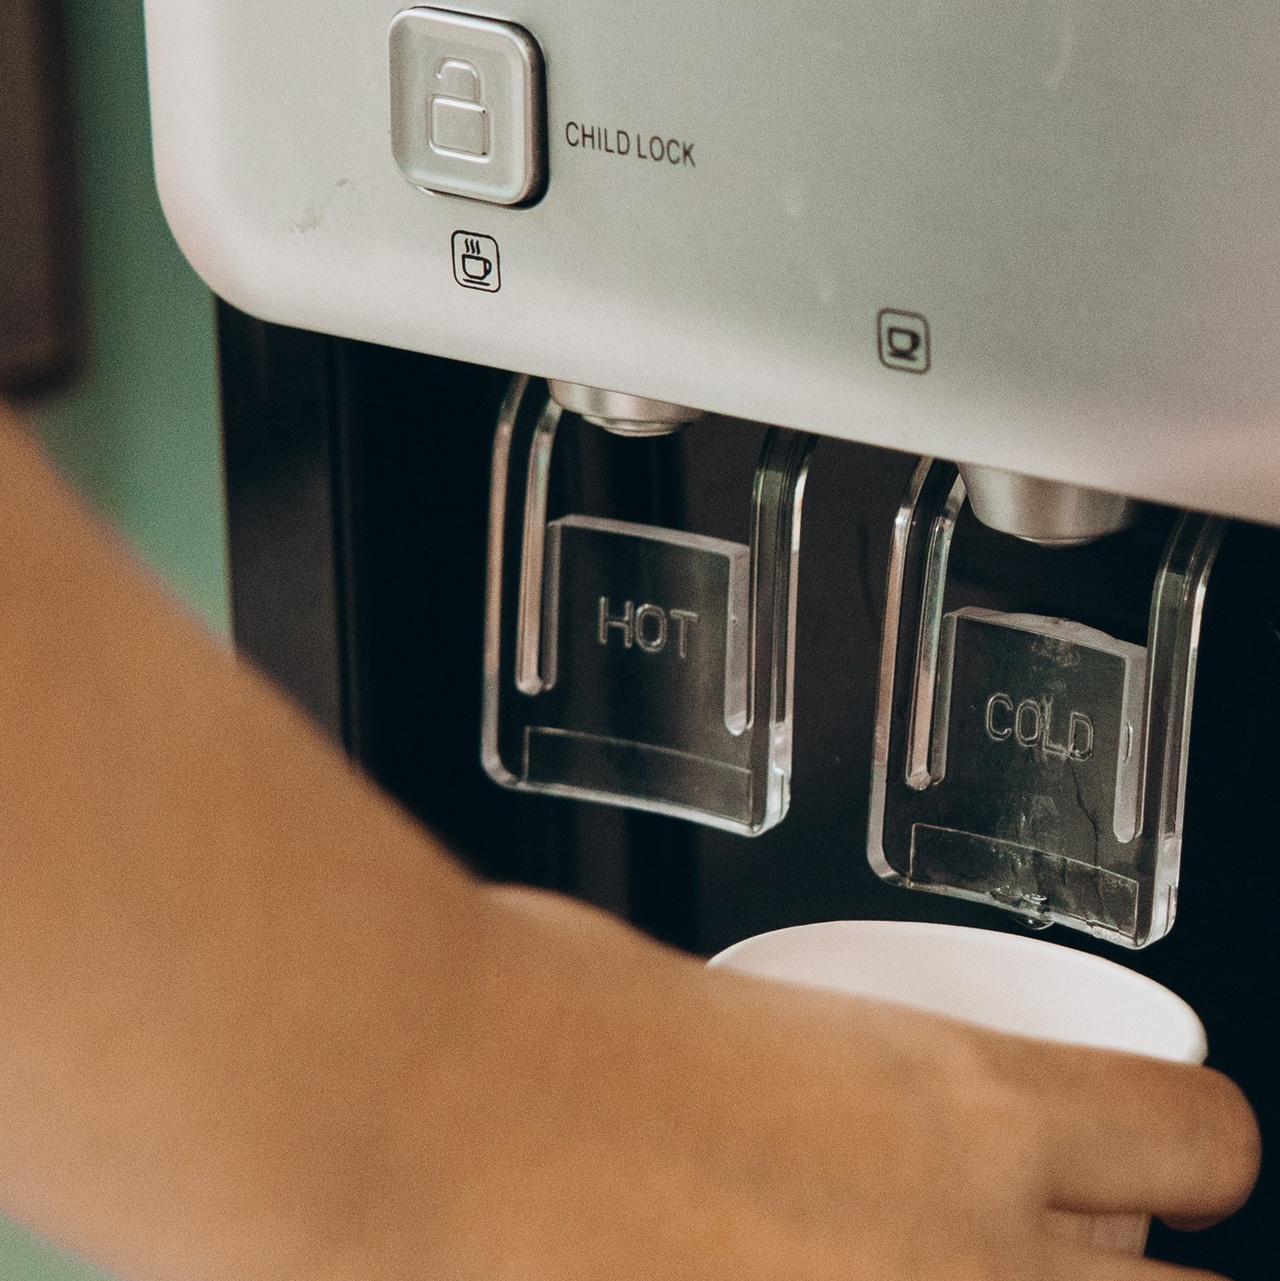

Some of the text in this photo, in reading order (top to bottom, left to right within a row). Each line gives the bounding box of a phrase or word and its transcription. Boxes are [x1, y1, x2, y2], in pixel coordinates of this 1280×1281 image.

[565, 121, 697, 168] CHILD LOCK
[598, 596, 699, 659] HOT
[986, 693, 1094, 762] COLD
